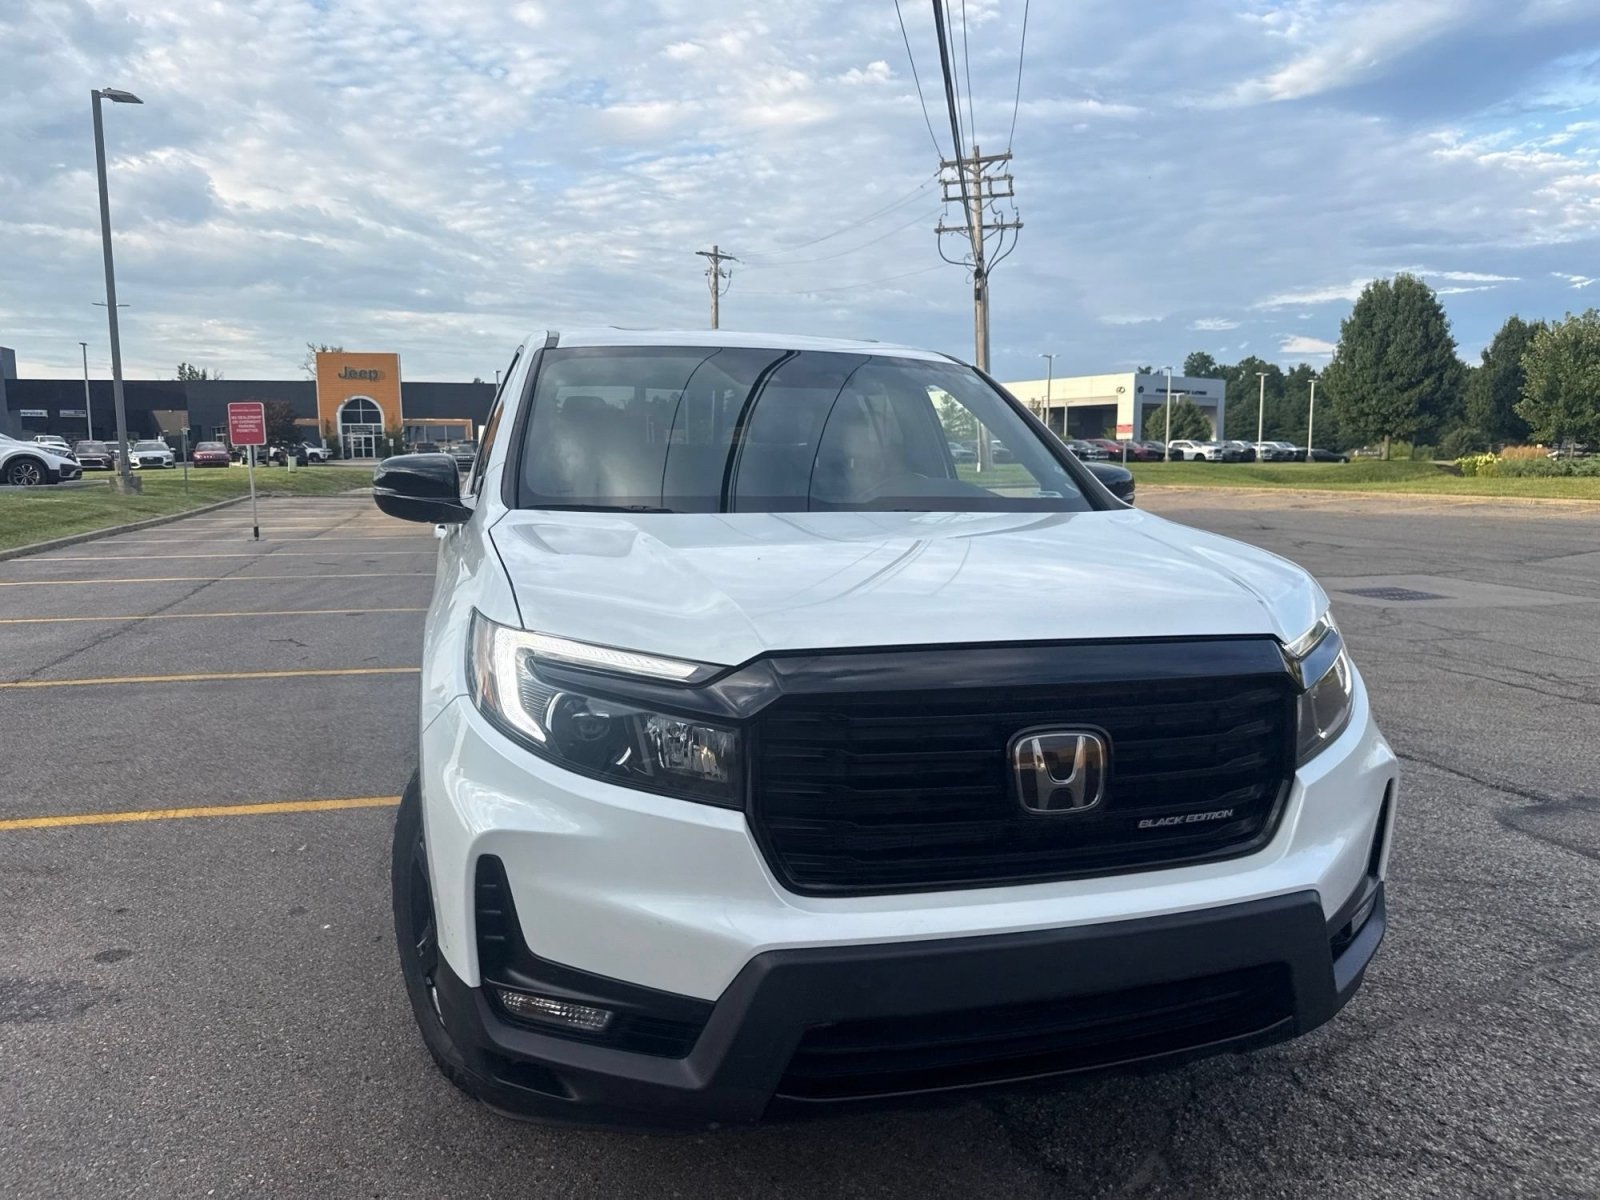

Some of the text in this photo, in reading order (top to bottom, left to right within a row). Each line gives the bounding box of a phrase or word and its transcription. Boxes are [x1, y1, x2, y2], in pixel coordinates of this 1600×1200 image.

[338, 366, 378, 382] Jeep
[1137, 808, 1234, 829] BLACK EDITION
